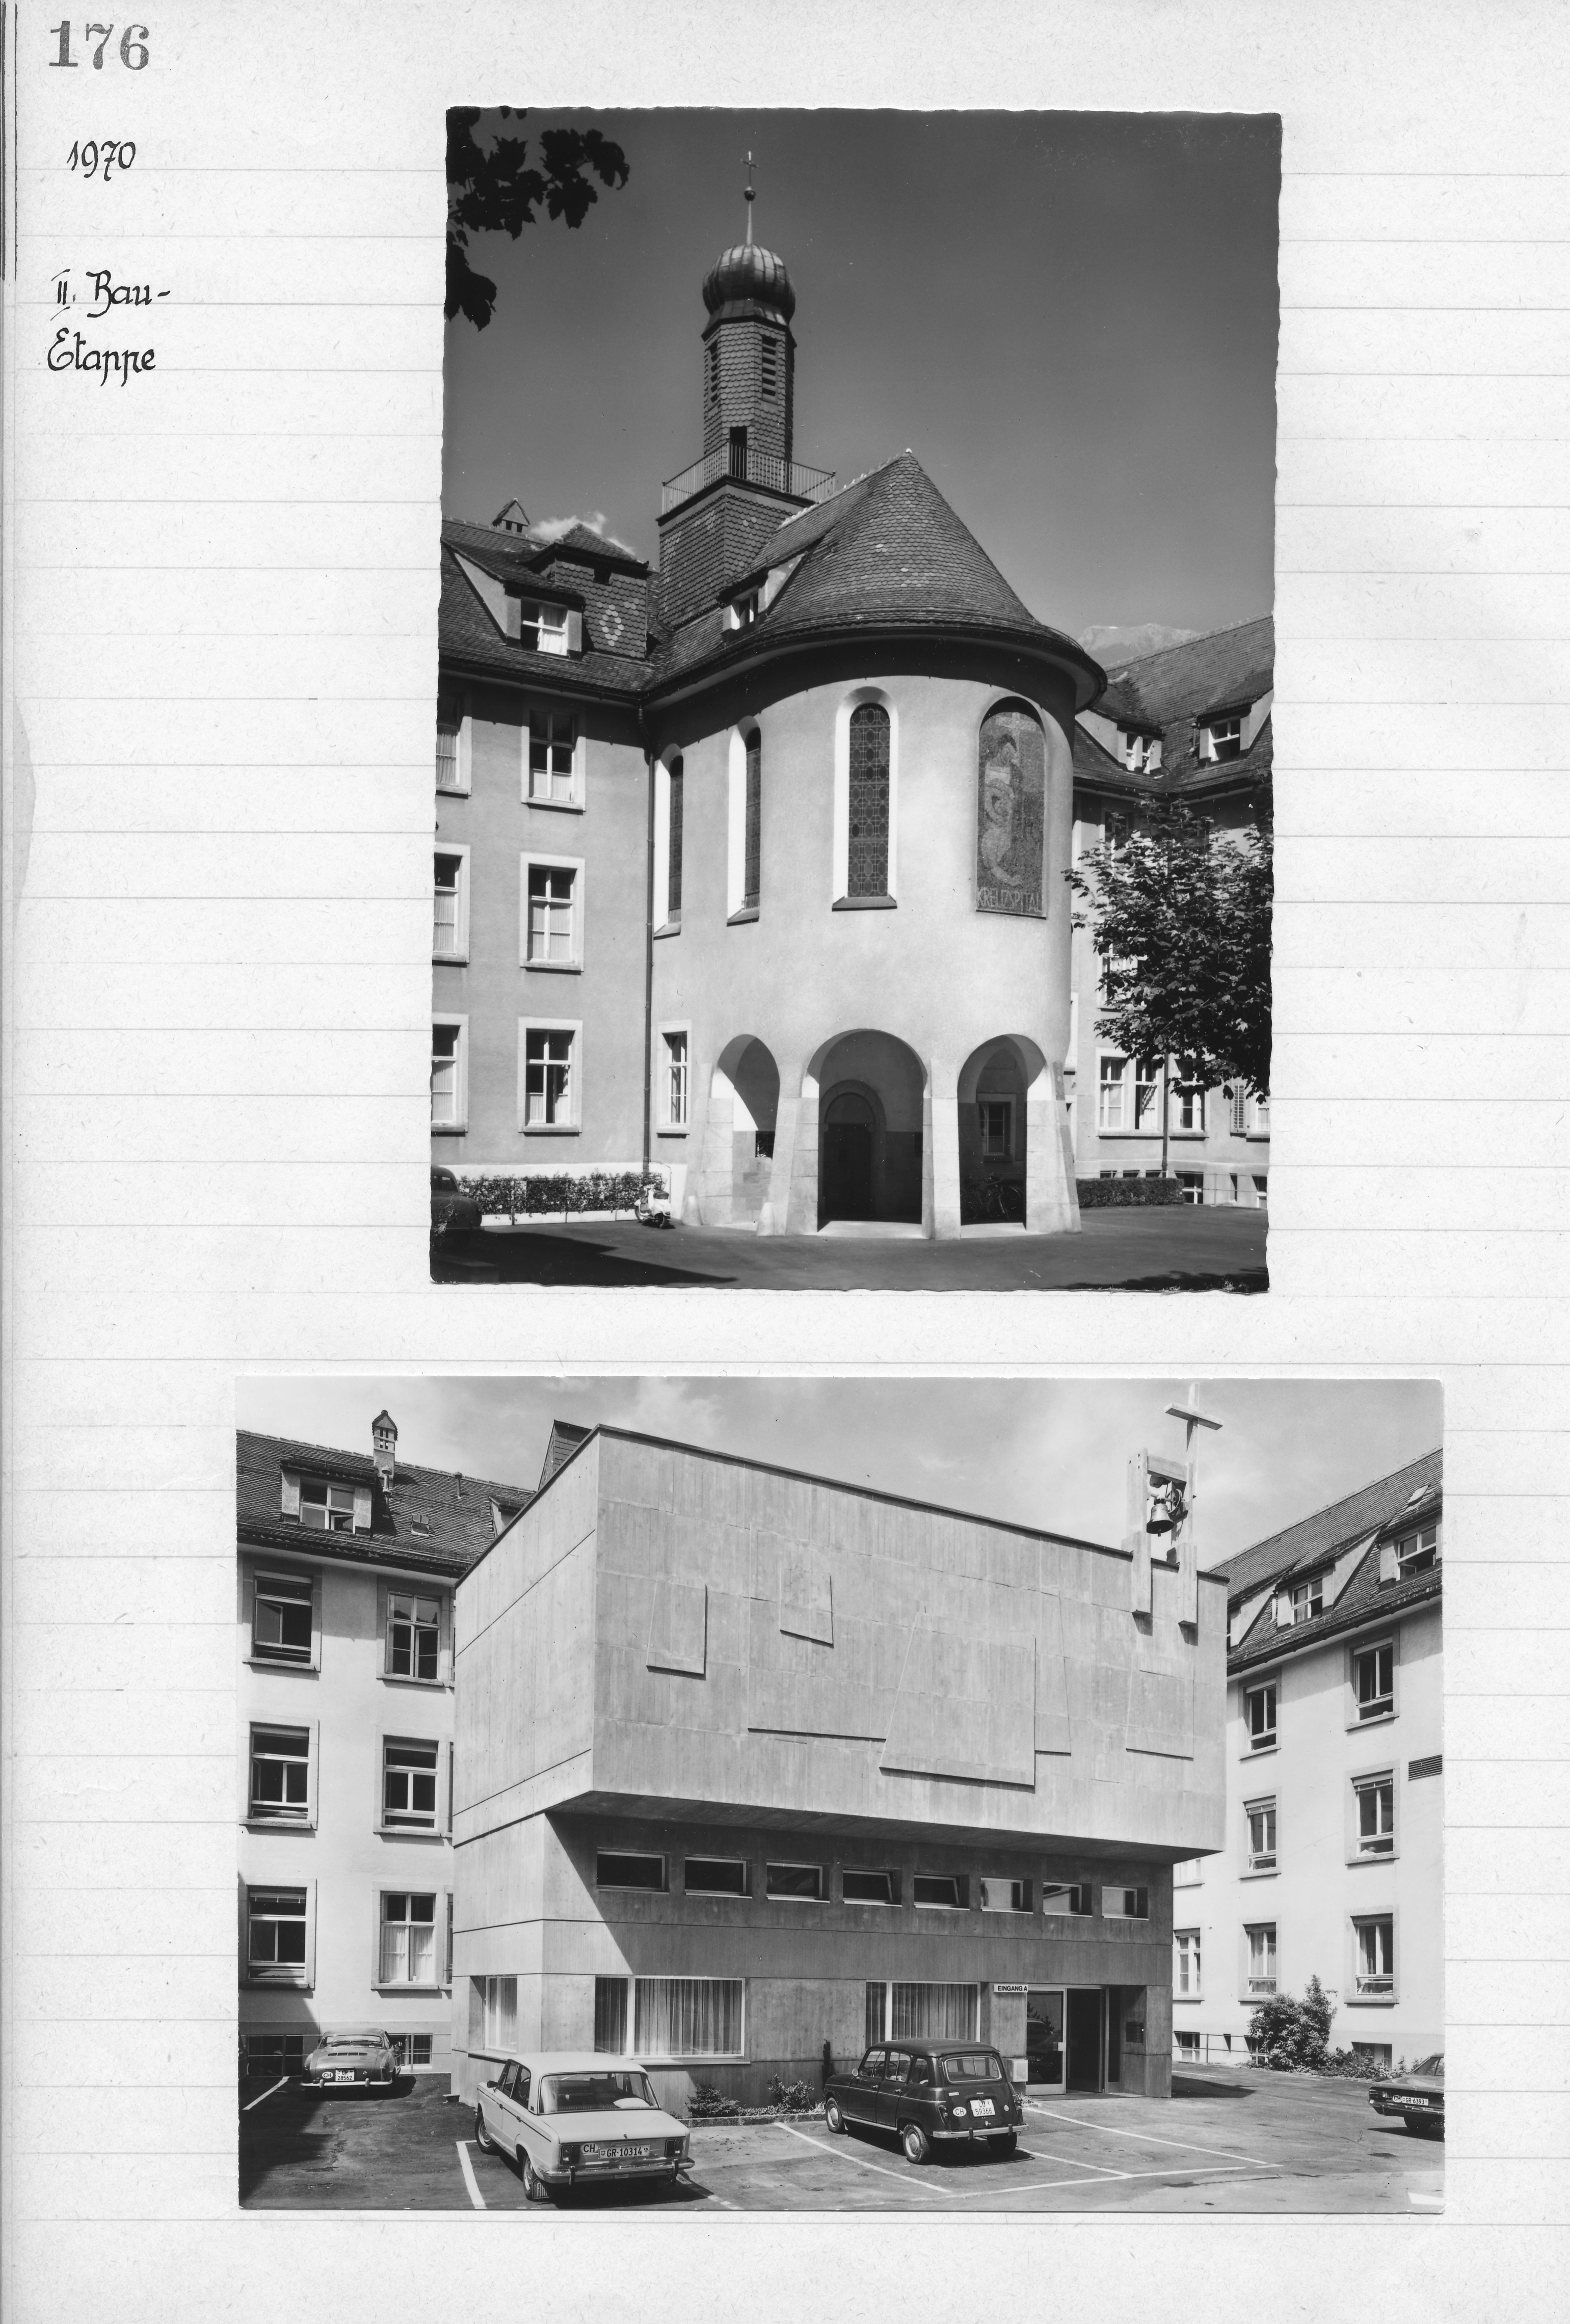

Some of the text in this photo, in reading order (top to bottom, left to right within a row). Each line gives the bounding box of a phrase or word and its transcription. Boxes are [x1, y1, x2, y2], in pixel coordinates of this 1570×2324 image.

[49, 21, 150, 70] 176
[67, 140, 136, 181] 1970
[86, 270, 171, 318] Bau-
[47, 327, 156, 387] Etappe
[976, 887, 1043, 913] KREUZSPITAL
[583, 2144, 595, 2153] CH
